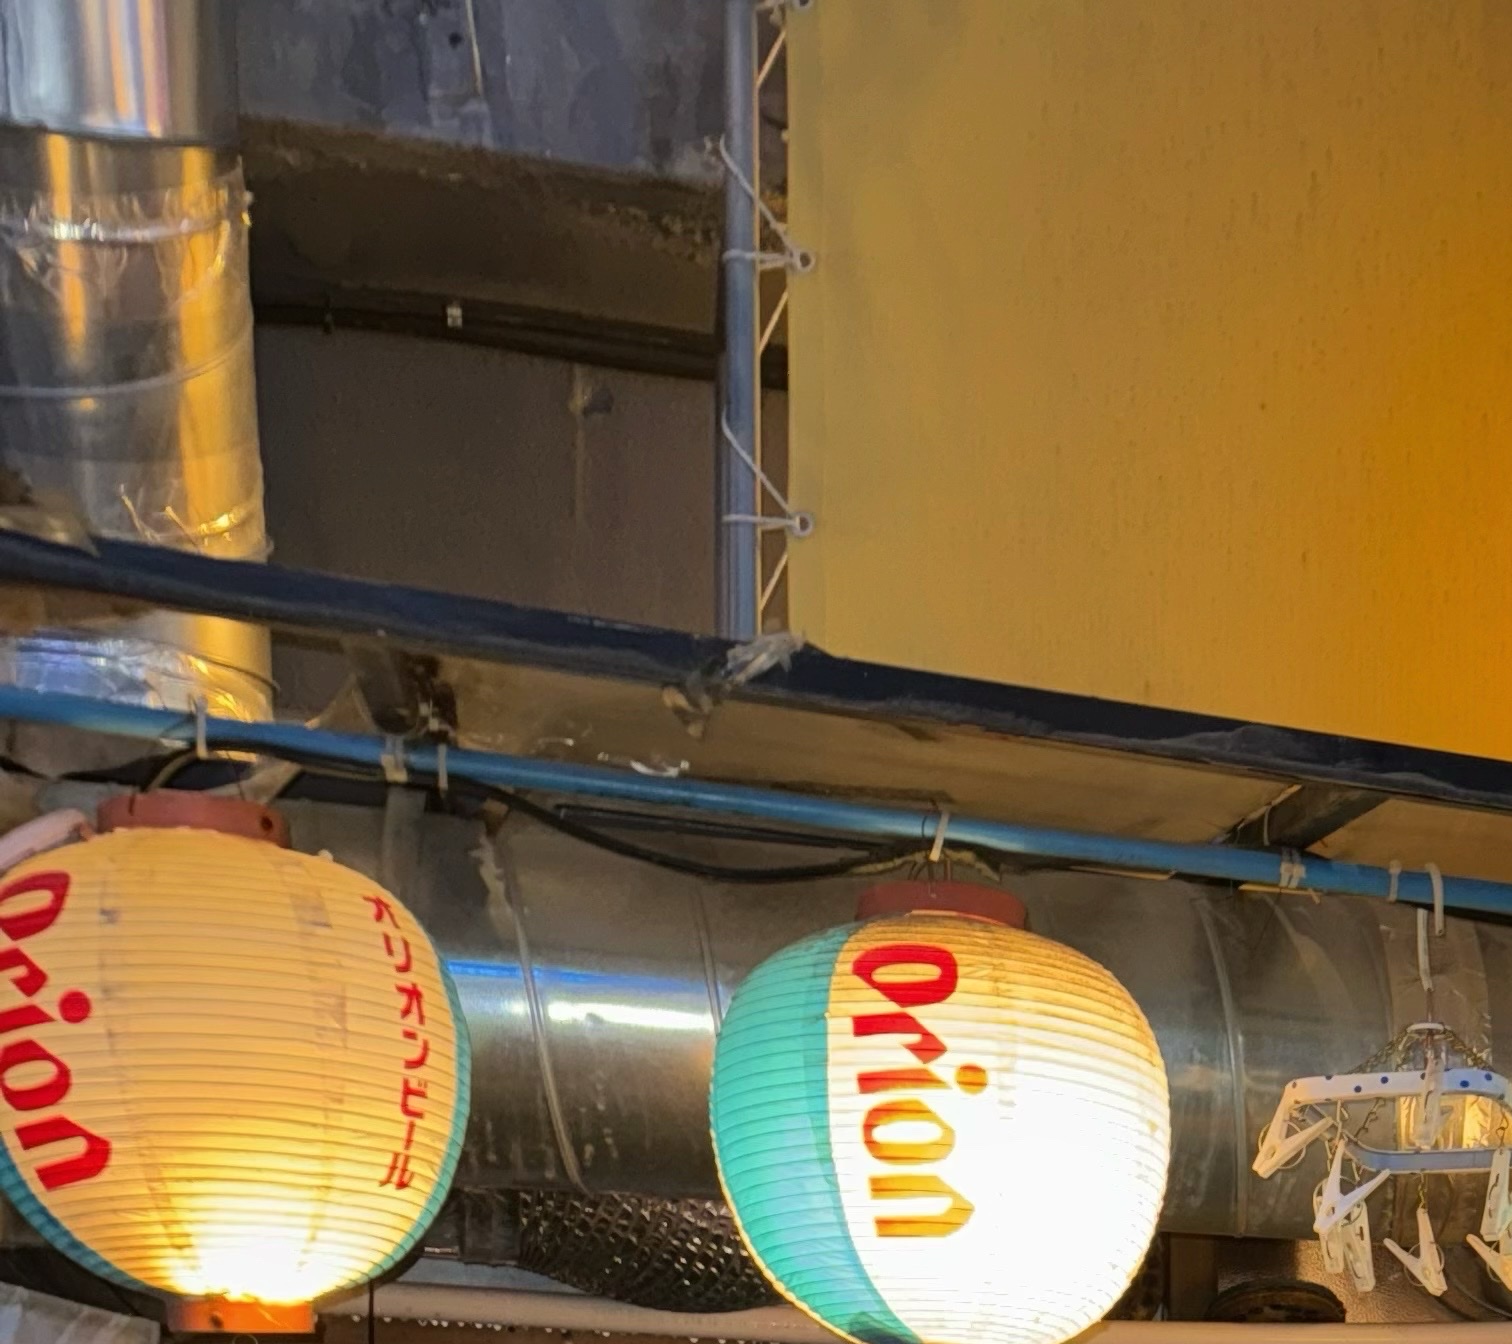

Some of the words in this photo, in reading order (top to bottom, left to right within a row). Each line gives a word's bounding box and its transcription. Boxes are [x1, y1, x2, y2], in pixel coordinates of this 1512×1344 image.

[0, 869, 113, 1193] Orion
[363, 893, 431, 1193] オリオンビール
[852, 942, 989, 1239] Orion
